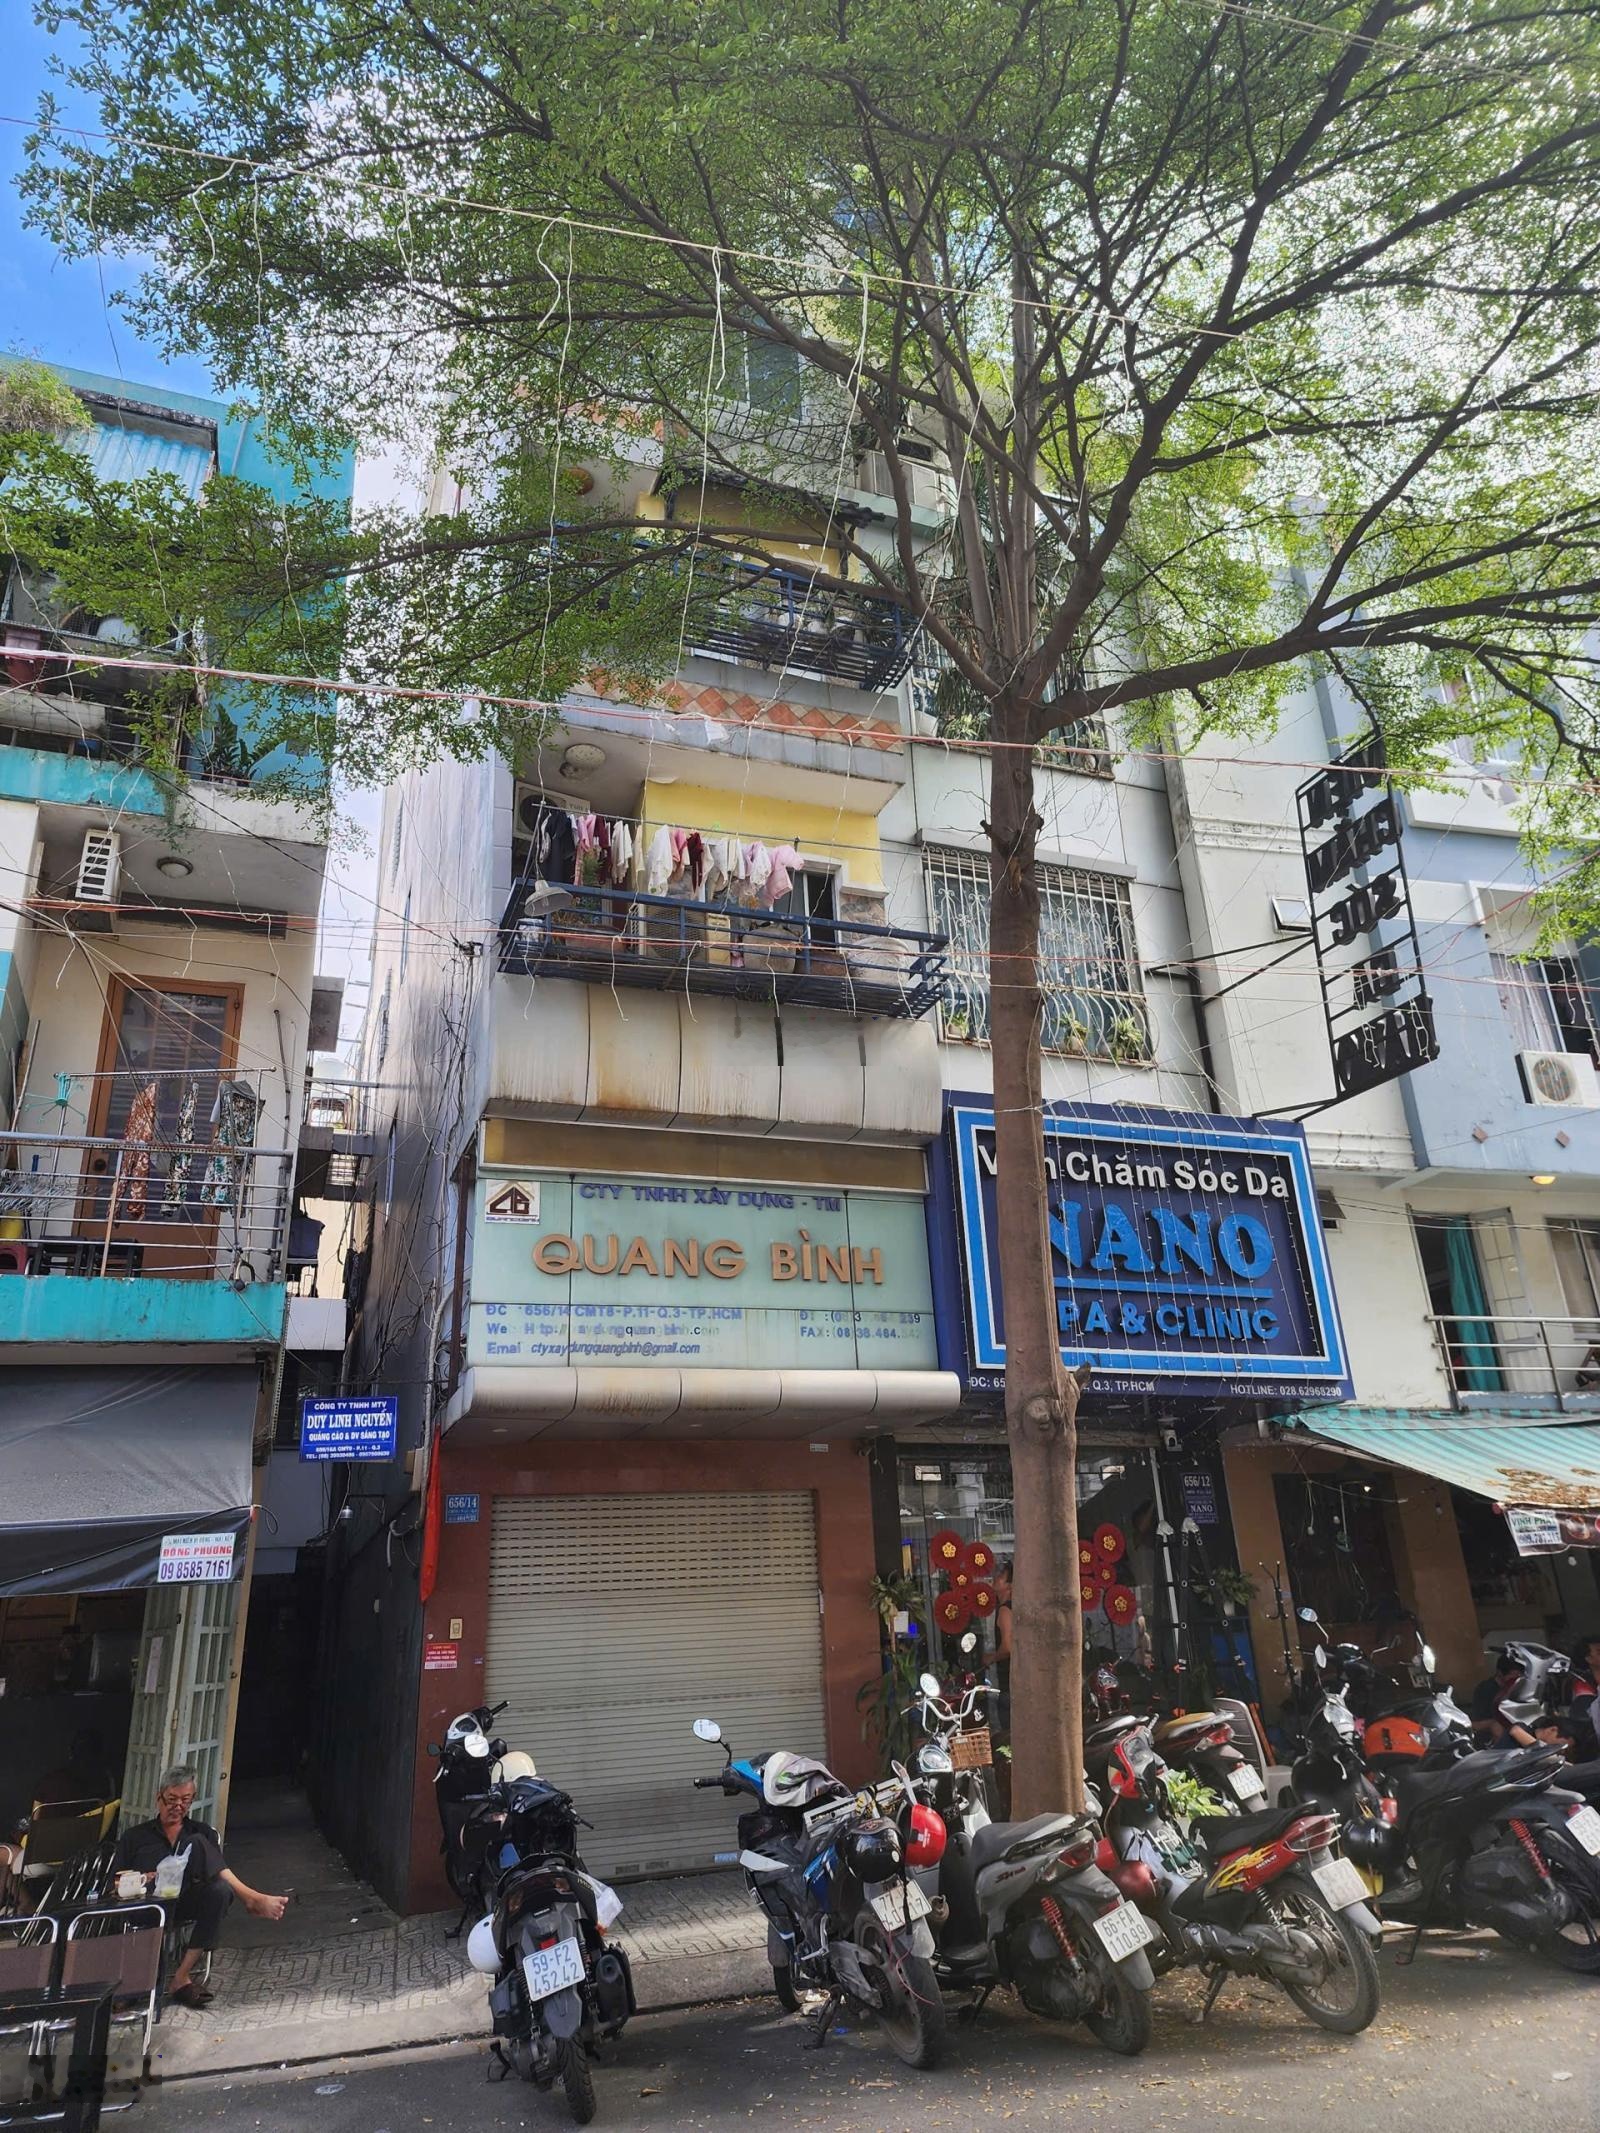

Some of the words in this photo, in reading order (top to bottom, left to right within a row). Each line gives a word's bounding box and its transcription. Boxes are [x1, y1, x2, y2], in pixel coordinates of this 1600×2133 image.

[978, 1145, 1057, 1180] Vn
[1066, 1151, 1167, 1188] Chăm
[1174, 1158, 1239, 1194] Sóc
[1245, 1166, 1290, 1199] Da
[580, 1183, 623, 1200] CTY
[632, 1186, 687, 1203] TNHH
[694, 1186, 731, 1206] XÂY
[814, 1197, 841, 1212] TM
[1050, 1199, 1274, 1280] NANO
[533, 1233, 746, 1279] QUANG
[770, 1229, 884, 1285] BÌNH
[1058, 1300, 1112, 1334] PA
[1121, 1301, 1147, 1336] &
[1156, 1303, 1280, 1340] CLINIC
[1230, 1384, 1278, 1396] HOTLINE:
[314, 1402, 335, 1410] CÔNG
[307, 1415, 327, 1429] DUY
[329, 1414, 352, 1429] LINH
[449, 1497, 477, 1508] 656/14
[1190, 1504, 1214, 1513] NANO
[160, 1562, 174, 1580] 09
[176, 1560, 203, 1579] 8585
[205, 1559, 231, 1578] 7161
[1101, 1908, 1135, 1938] 66-FA
[1110, 1924, 1148, 1956] 110.99
[532, 1944, 571, 1975] 59-F2
[534, 1962, 580, 1996] 452.42
